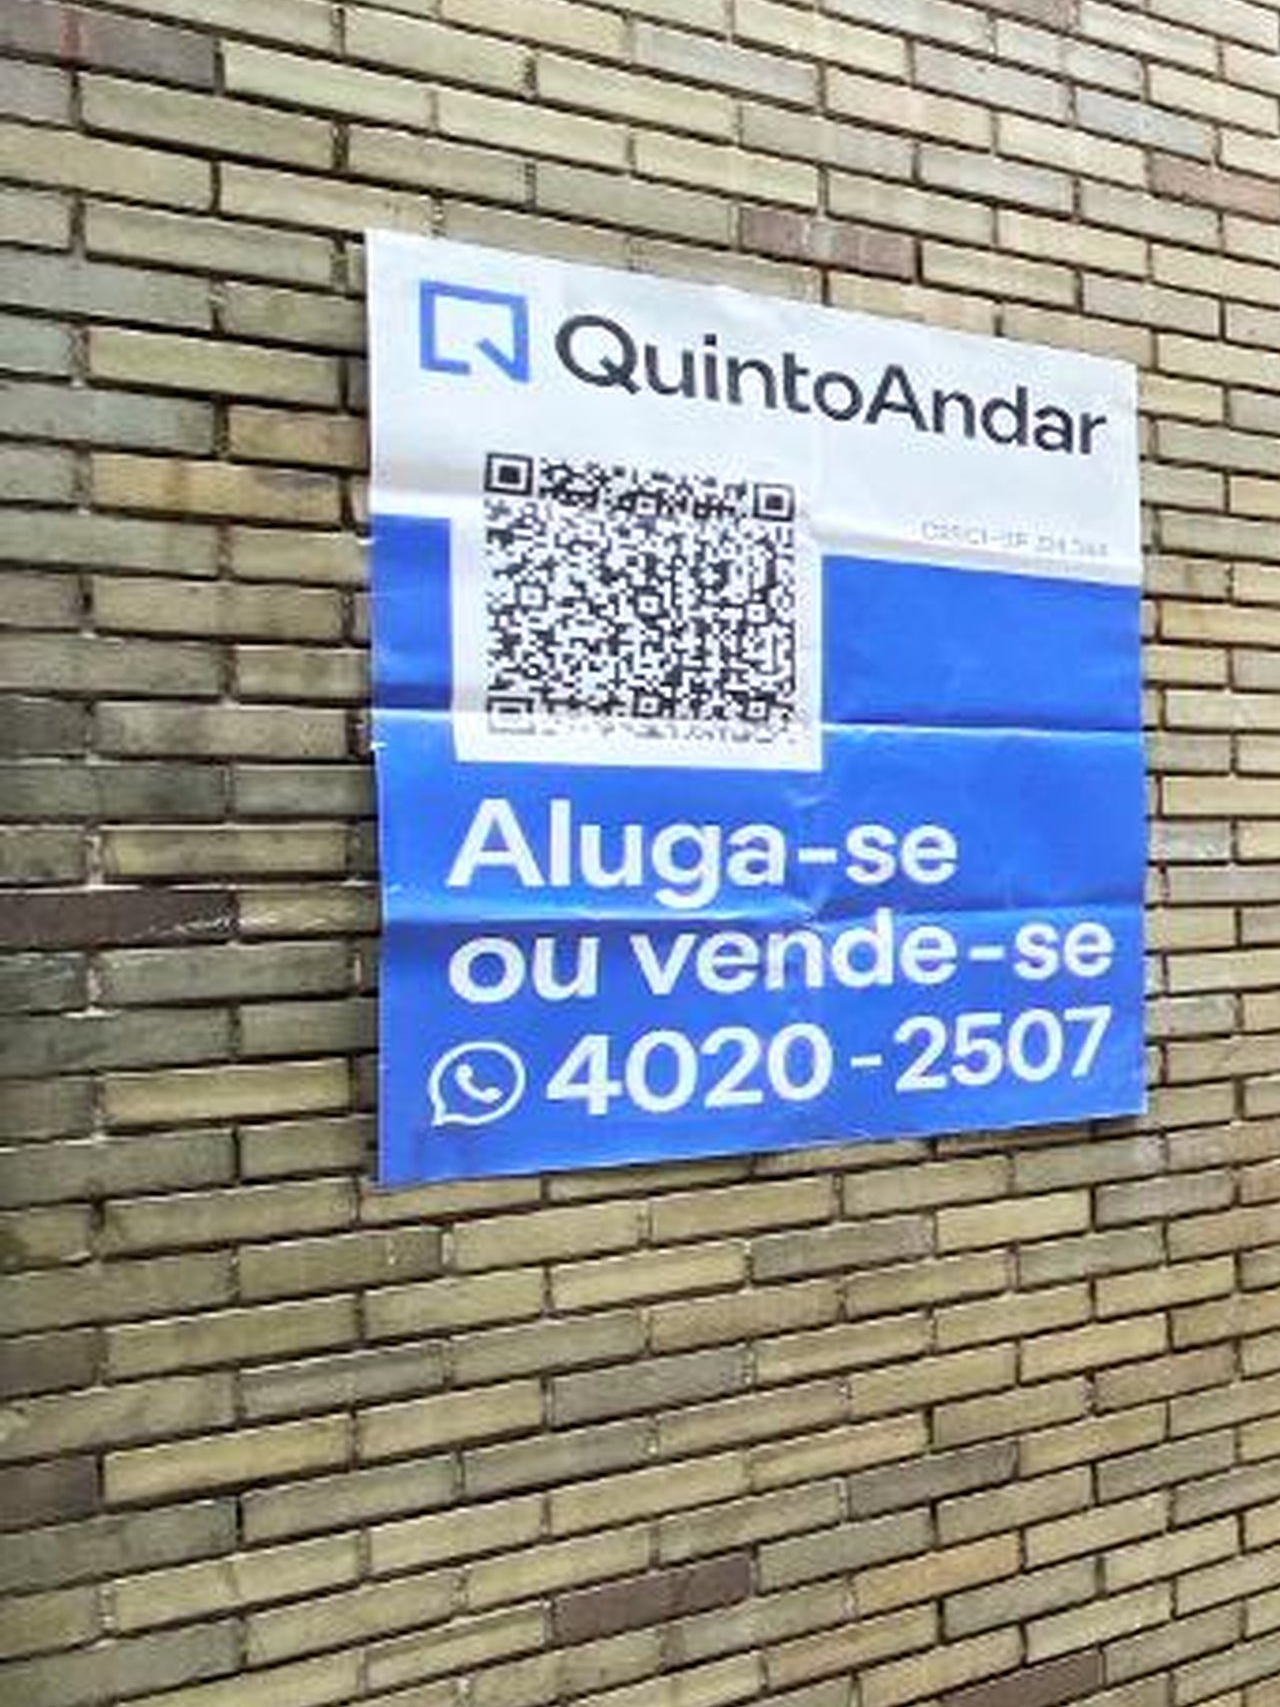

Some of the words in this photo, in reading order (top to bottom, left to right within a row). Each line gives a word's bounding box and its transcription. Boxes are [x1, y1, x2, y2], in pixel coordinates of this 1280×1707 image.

[553, 313, 1108, 457] QuintoAndar
[447, 797, 958, 908] Aluga-se
[447, 934, 600, 1005] ou
[629, 909, 1114, 995] vende-se
